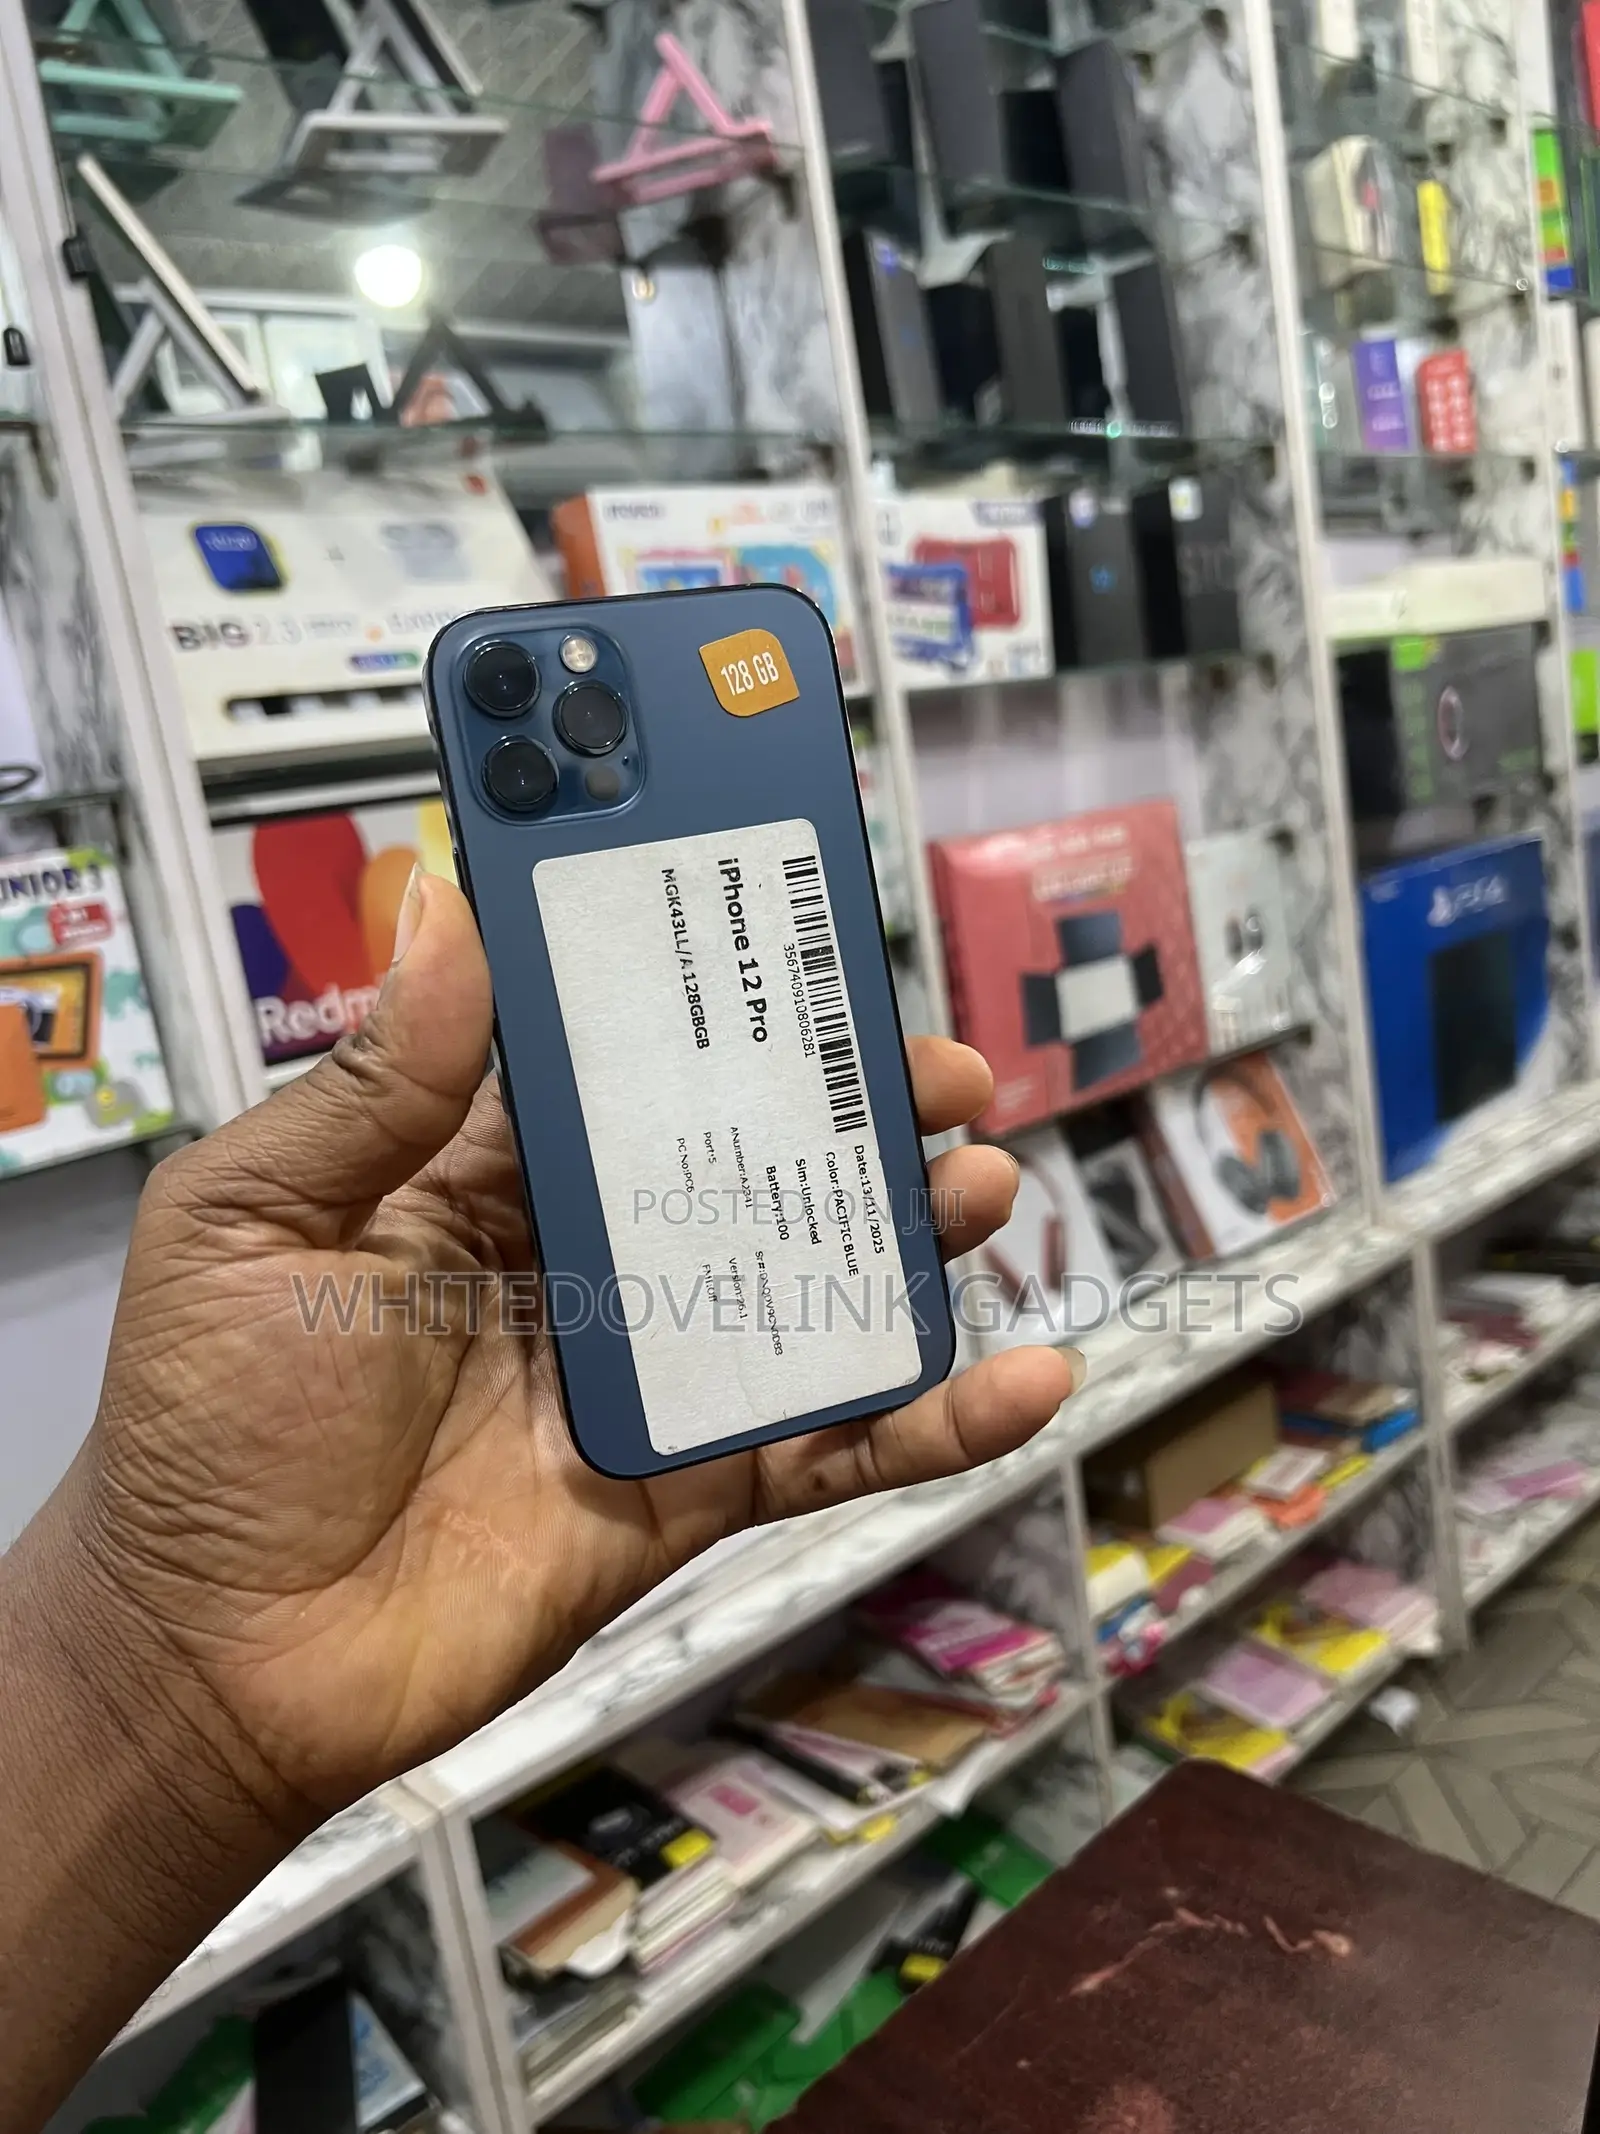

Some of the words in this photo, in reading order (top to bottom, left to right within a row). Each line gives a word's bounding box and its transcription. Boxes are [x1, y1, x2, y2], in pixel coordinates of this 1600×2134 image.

[720, 659, 755, 697] 128
[752, 651, 779, 686] GB
[717, 857, 752, 951] iPhone
[660, 867, 694, 970] MGK43LL/A
[681, 971, 710, 1050] 128GBGB
[736, 956, 763, 993] 12
[255, 981, 383, 1047] Redm
[744, 996, 768, 1043] Pro
[782, 942, 816, 1059] 356740910806281
[702, 1130, 717, 1164] Port:5
[729, 1125, 753, 1208] ANumber:A2341
[764, 1164, 790, 1241] Battery:100
[794, 1157, 822, 1245] Sim:Unlocked
[824, 1150, 852, 1243] Color:PACIFIC
[842, 1242, 859, 1277] BLUE
[853, 1143, 885, 1254] Date:13/11/2025
[727, 1256, 748, 1319] Version:26.1
